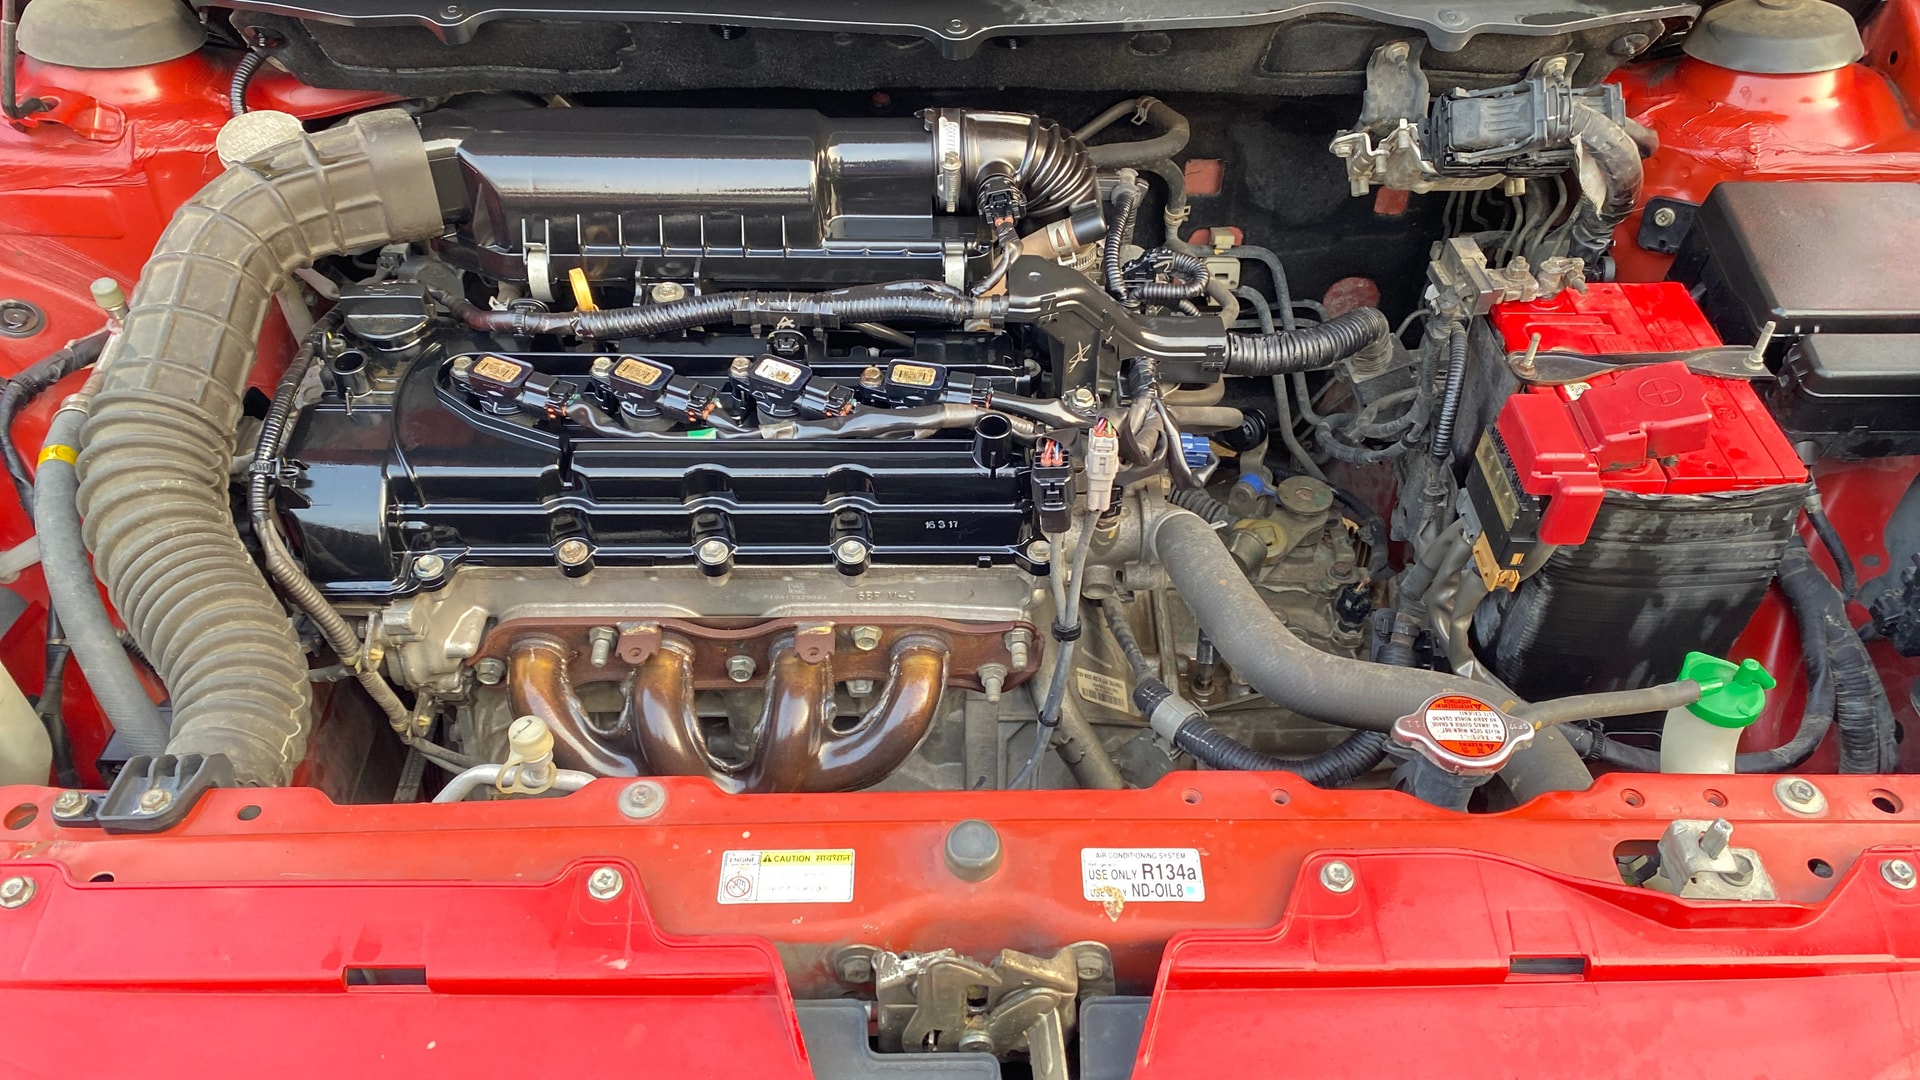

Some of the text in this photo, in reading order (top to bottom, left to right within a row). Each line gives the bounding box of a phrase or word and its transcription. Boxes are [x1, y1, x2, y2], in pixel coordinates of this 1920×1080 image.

[948, 520, 958, 528] 17
[1088, 863, 1196, 880] USE ONLY R134a
[1132, 883, 1184, 897] ND-OIL8
